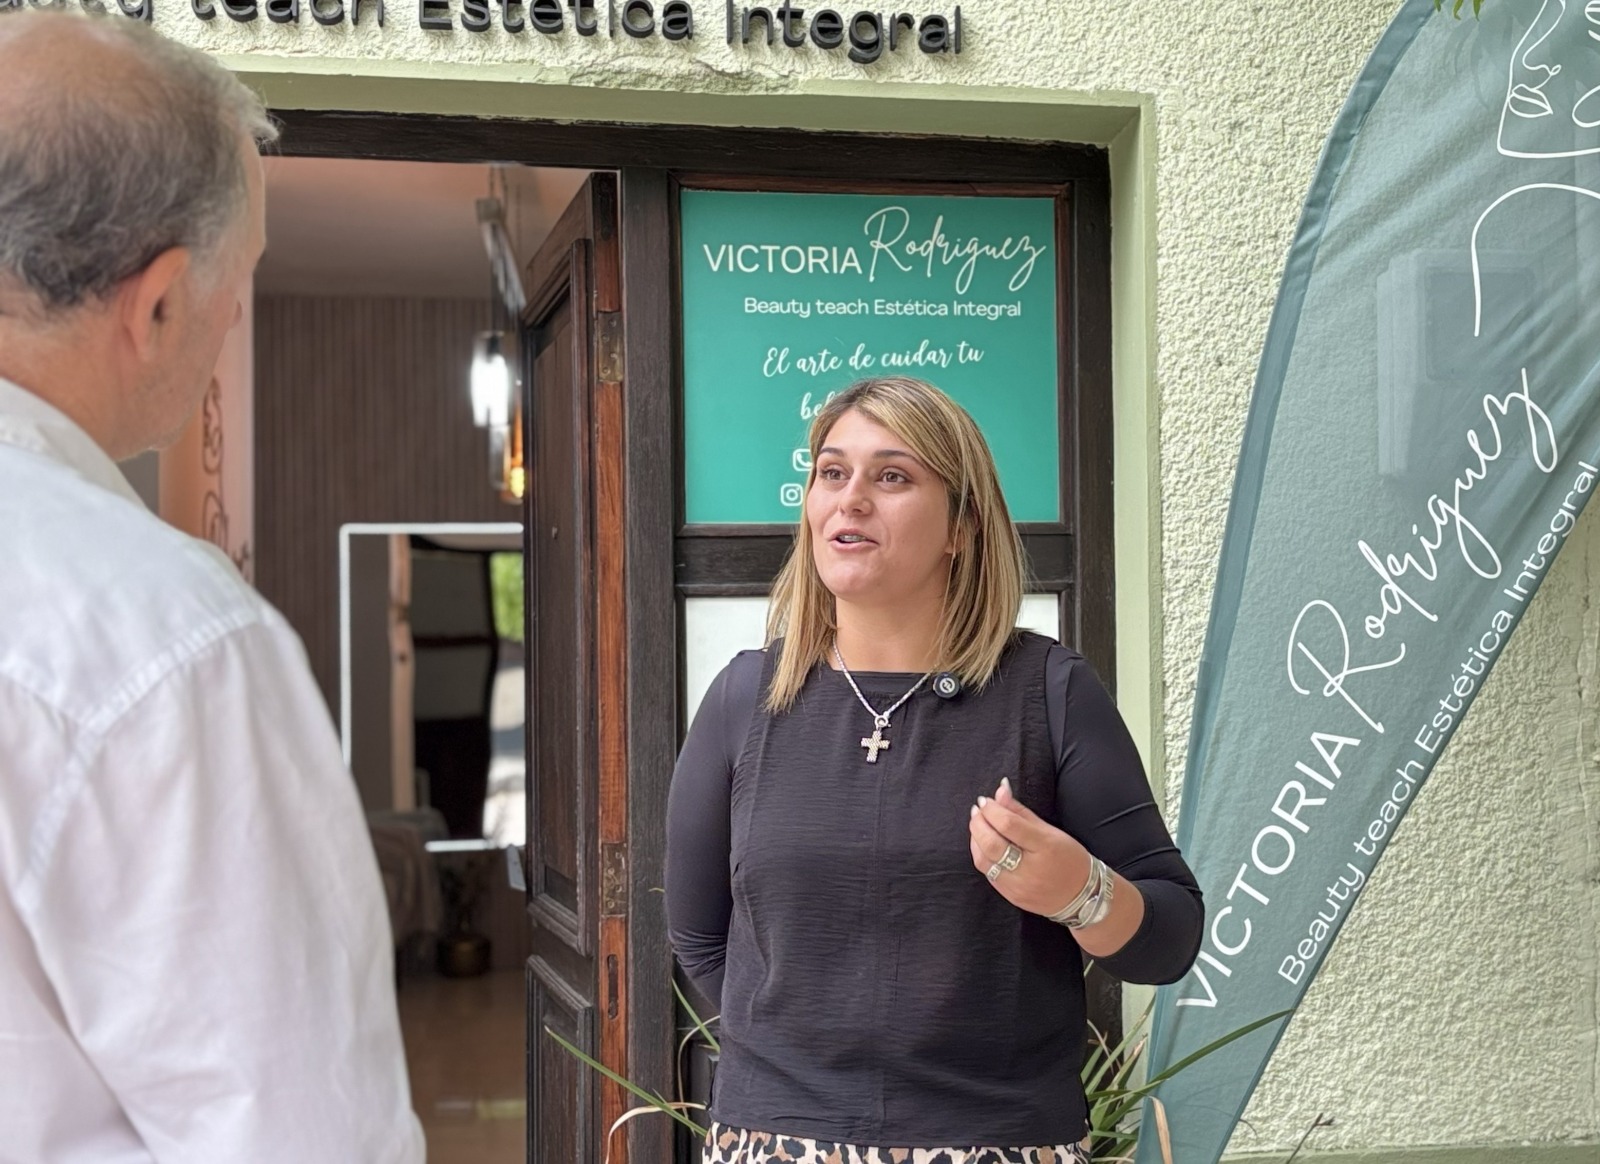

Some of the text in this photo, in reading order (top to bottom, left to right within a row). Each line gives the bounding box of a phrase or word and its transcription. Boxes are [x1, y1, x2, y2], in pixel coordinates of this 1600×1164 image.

[726, 0, 962, 64] Integral
[703, 206, 1046, 295] VICTORIA Rodriguez
[744, 297, 1022, 321] Beauty teach Estética Integral
[763, 339, 985, 377] El arte de cuidar tu
[1175, 367, 1559, 1008] VICTORIA Rodriguez
[1277, 460, 1599, 986] Beauty teach Estética Integral
